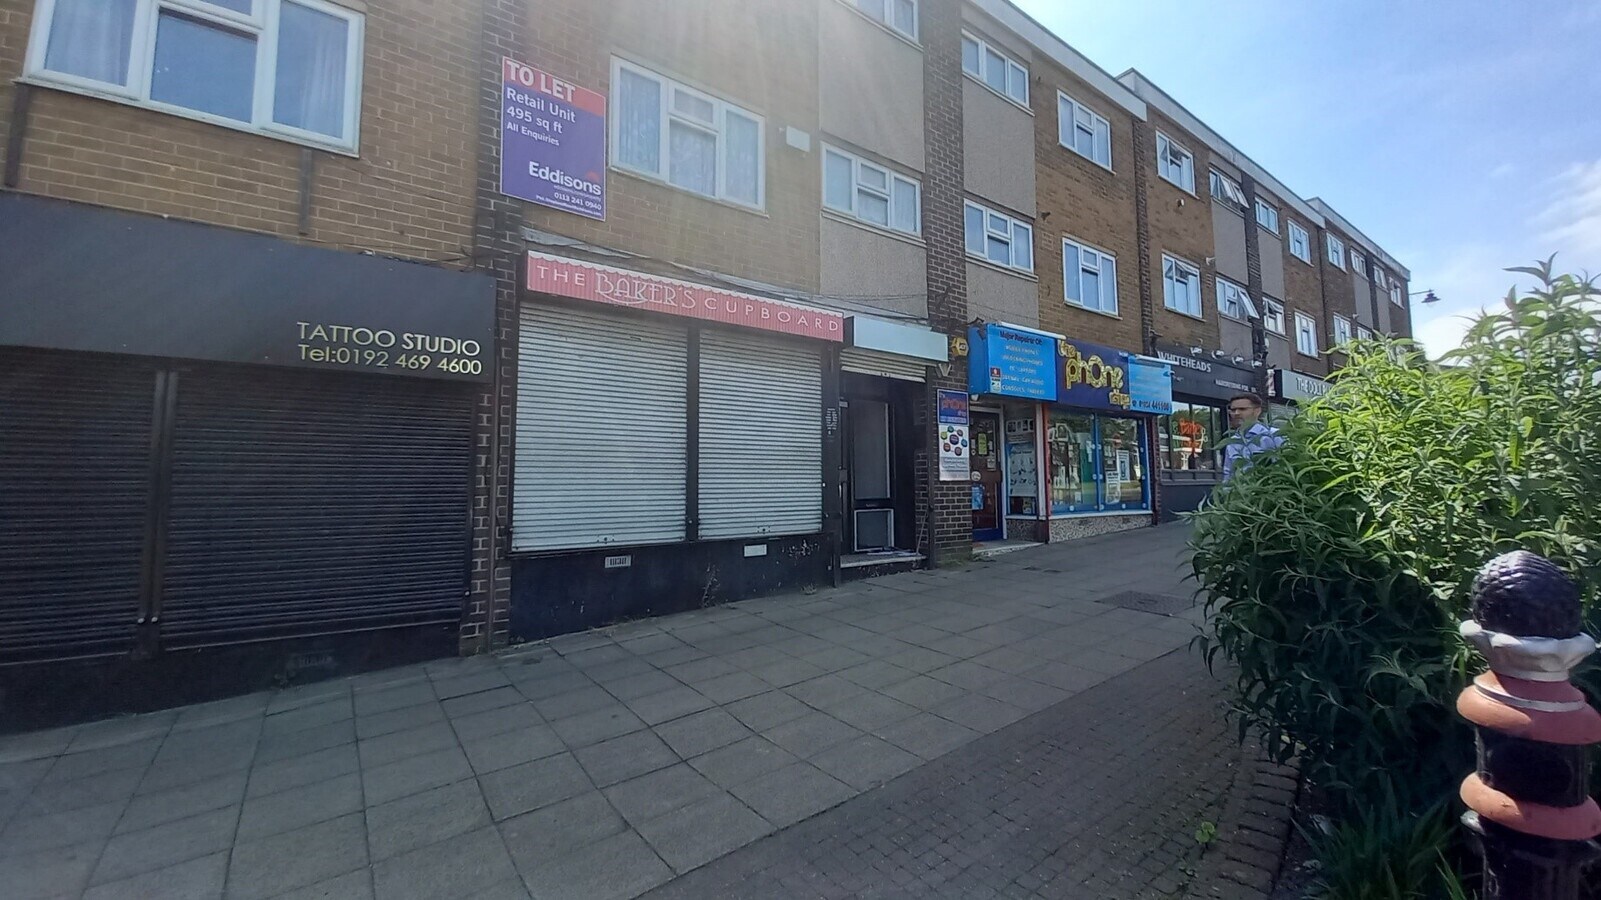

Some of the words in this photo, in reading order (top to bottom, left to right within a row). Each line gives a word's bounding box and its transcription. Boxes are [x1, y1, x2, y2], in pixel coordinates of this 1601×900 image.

[506, 60, 535, 87] TO
[540, 74, 576, 103] LET
[506, 87, 545, 112] Retail
[549, 102, 576, 123] Unit
[506, 106, 533, 122] 495
[536, 117, 550, 132] sq
[553, 121, 563, 134] ft
[506, 121, 519, 133] All
[521, 126, 560, 146] Enquiries
[529, 160, 602, 196] Eddisons
[554, 192, 571, 202] 0113
[571, 196, 584, 206] 241
[585, 201, 602, 211] 0940
[536, 265, 586, 287] THE
[594, 271, 697, 309] BAKER'S
[704, 297, 839, 331] CUPBOARD
[297, 321, 396, 348] TATTOO
[402, 332, 481, 357] STUDIO
[298, 344, 390, 368] Tel:0192
[394, 353, 432, 371] 469
[436, 357, 483, 375] 4600
[1157, 350, 1212, 373] WHITEHEADS
